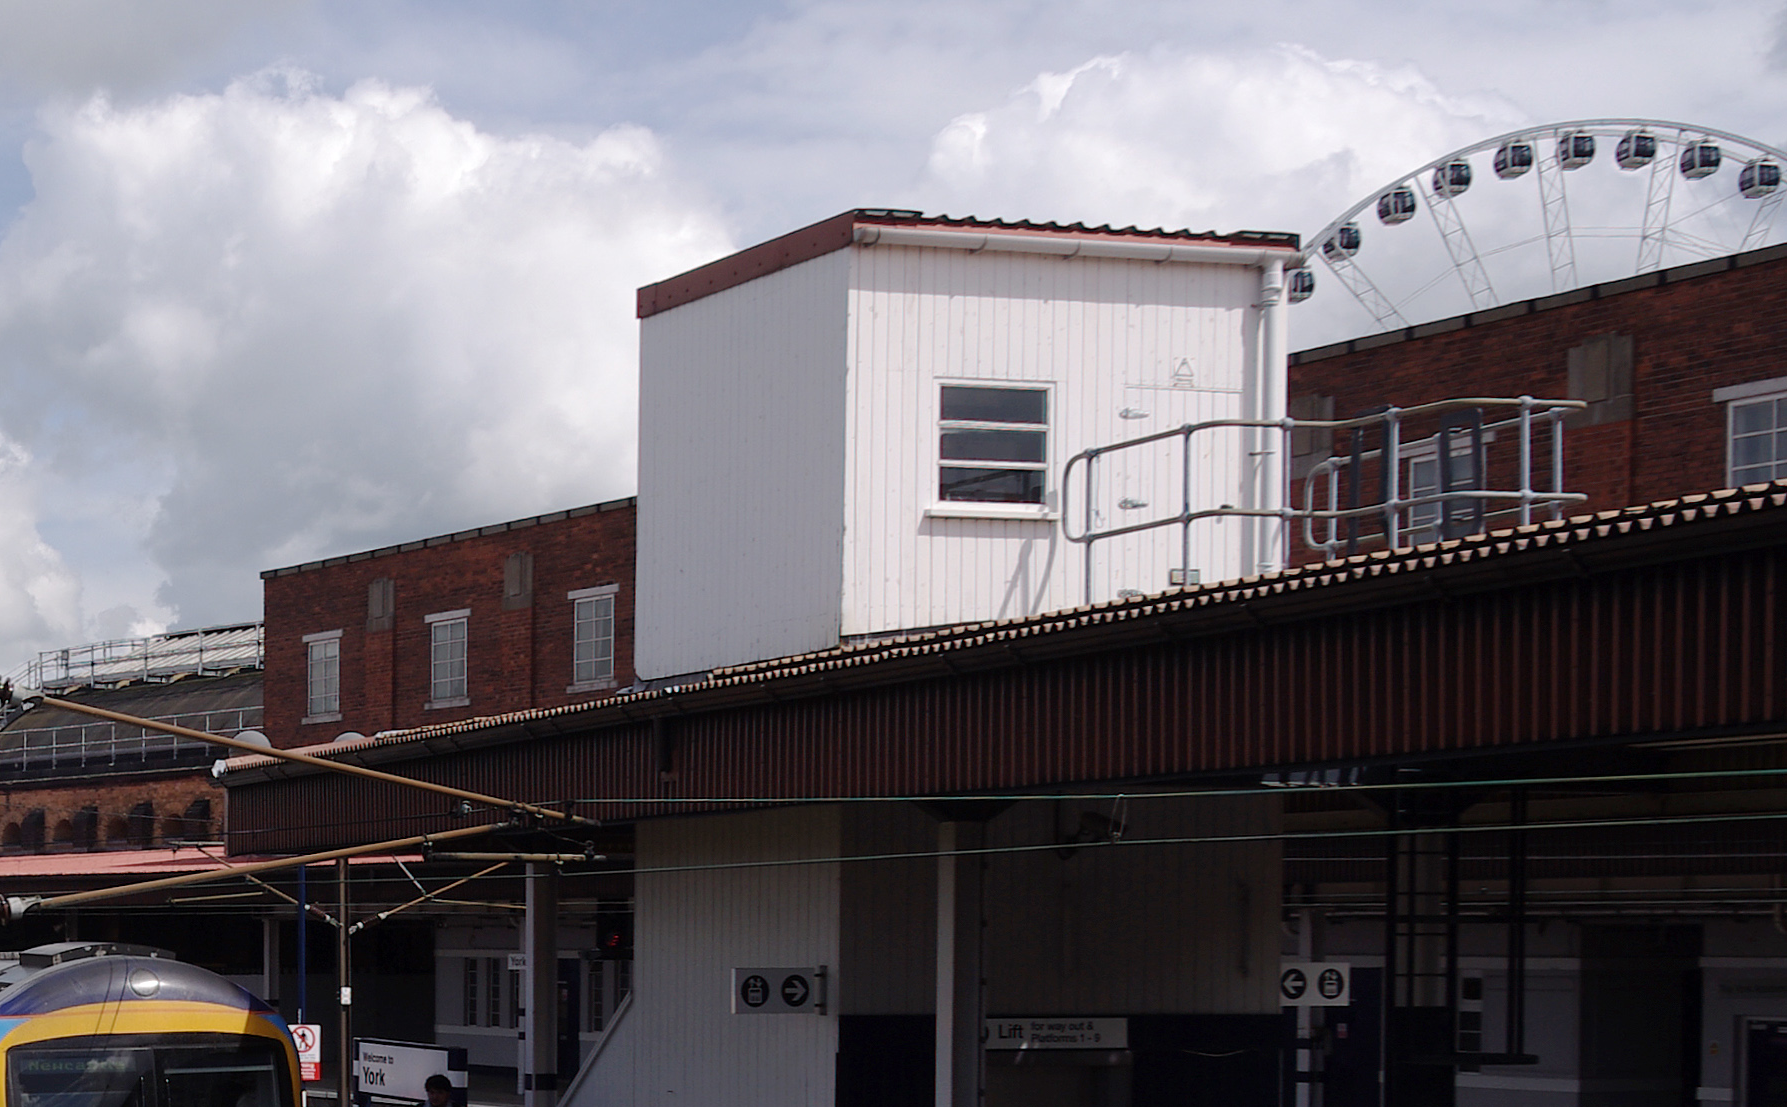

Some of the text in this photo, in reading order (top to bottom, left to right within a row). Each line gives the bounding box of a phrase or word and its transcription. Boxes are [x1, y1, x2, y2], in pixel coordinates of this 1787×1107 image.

[998, 1021, 1094, 1039] Lift for way out &
[1030, 1033, 1077, 1043] Platforms
[363, 1052, 394, 1065] Welcome to
[362, 1066, 386, 1086] York
